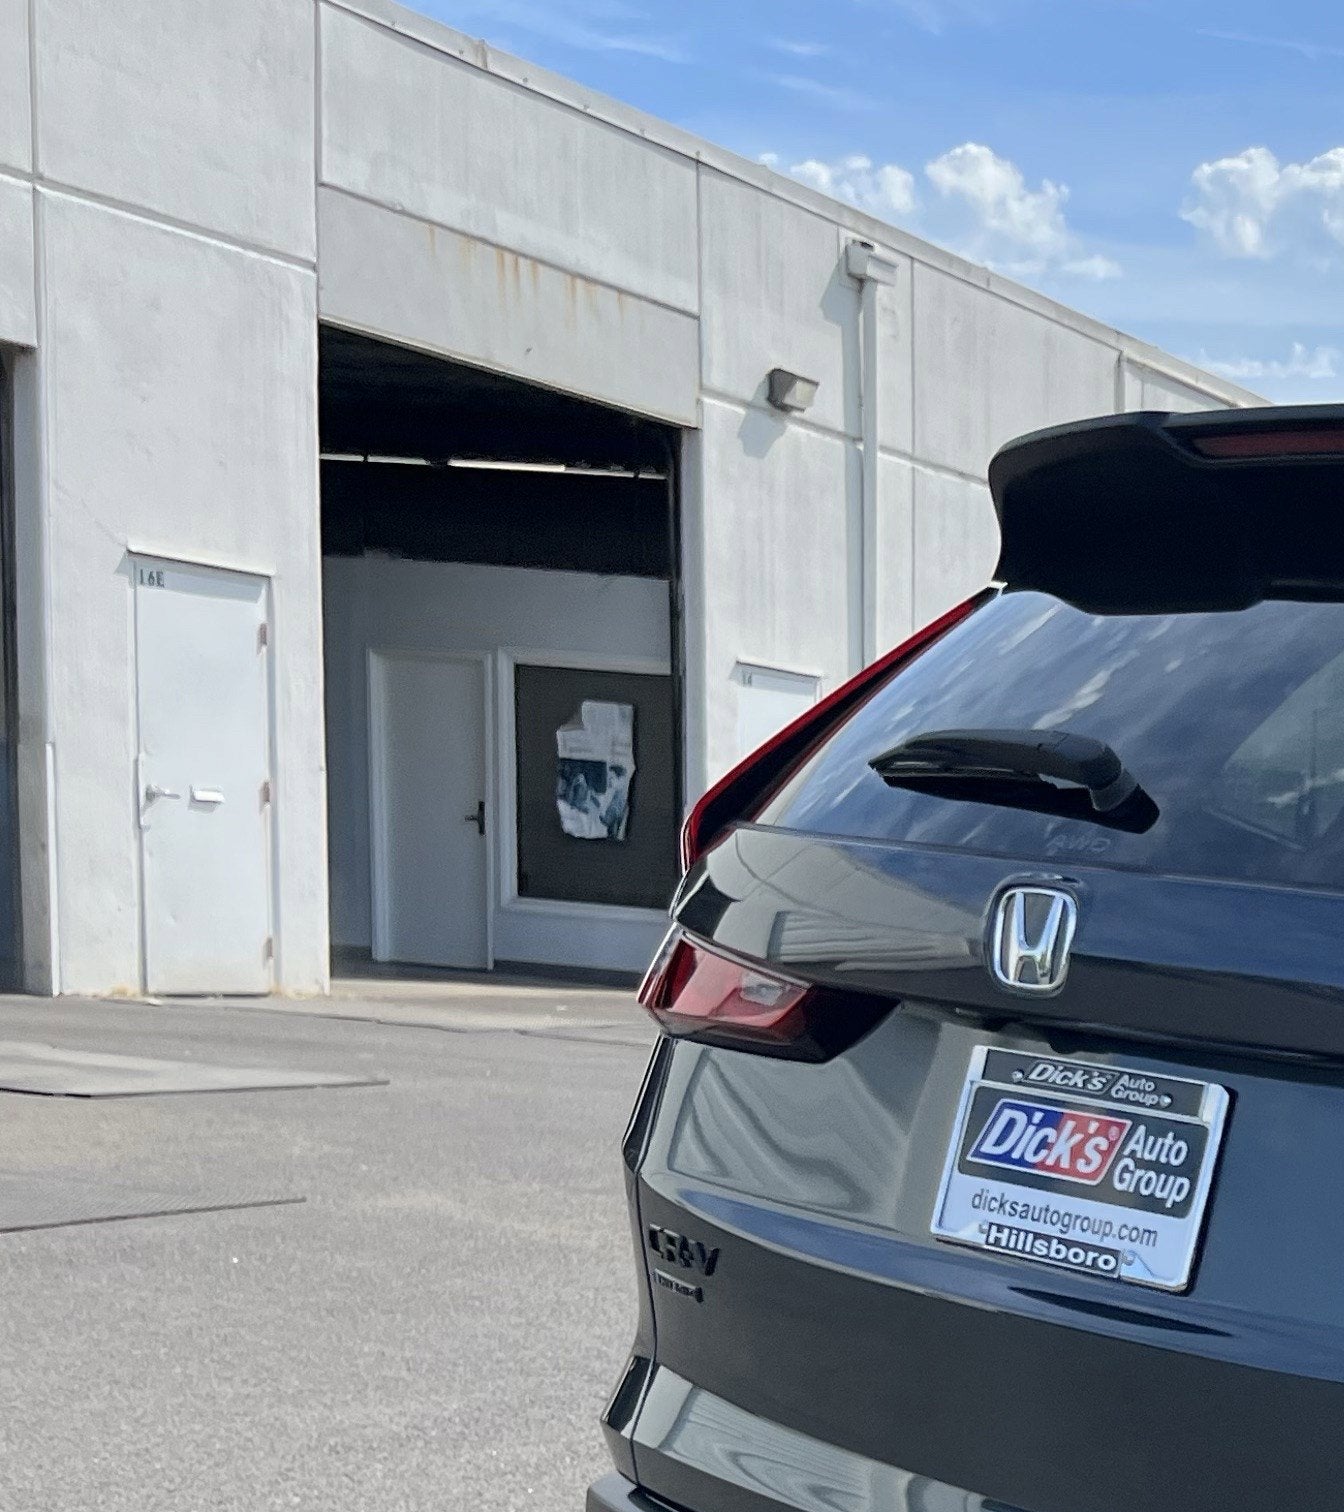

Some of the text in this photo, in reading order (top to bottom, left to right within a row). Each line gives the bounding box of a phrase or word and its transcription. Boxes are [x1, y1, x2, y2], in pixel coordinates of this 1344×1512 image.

[1028, 1062, 1108, 1091] Dick's
[1110, 1087, 1159, 1107] Group
[1115, 1074, 1155, 1092] Auto
[979, 1108, 1110, 1174] Dick's
[1123, 1124, 1189, 1167] Auto
[1112, 1157, 1191, 1208] Group
[970, 1189, 1159, 1248] dicksautogroup.com
[987, 1223, 1118, 1271] Hillsboro
